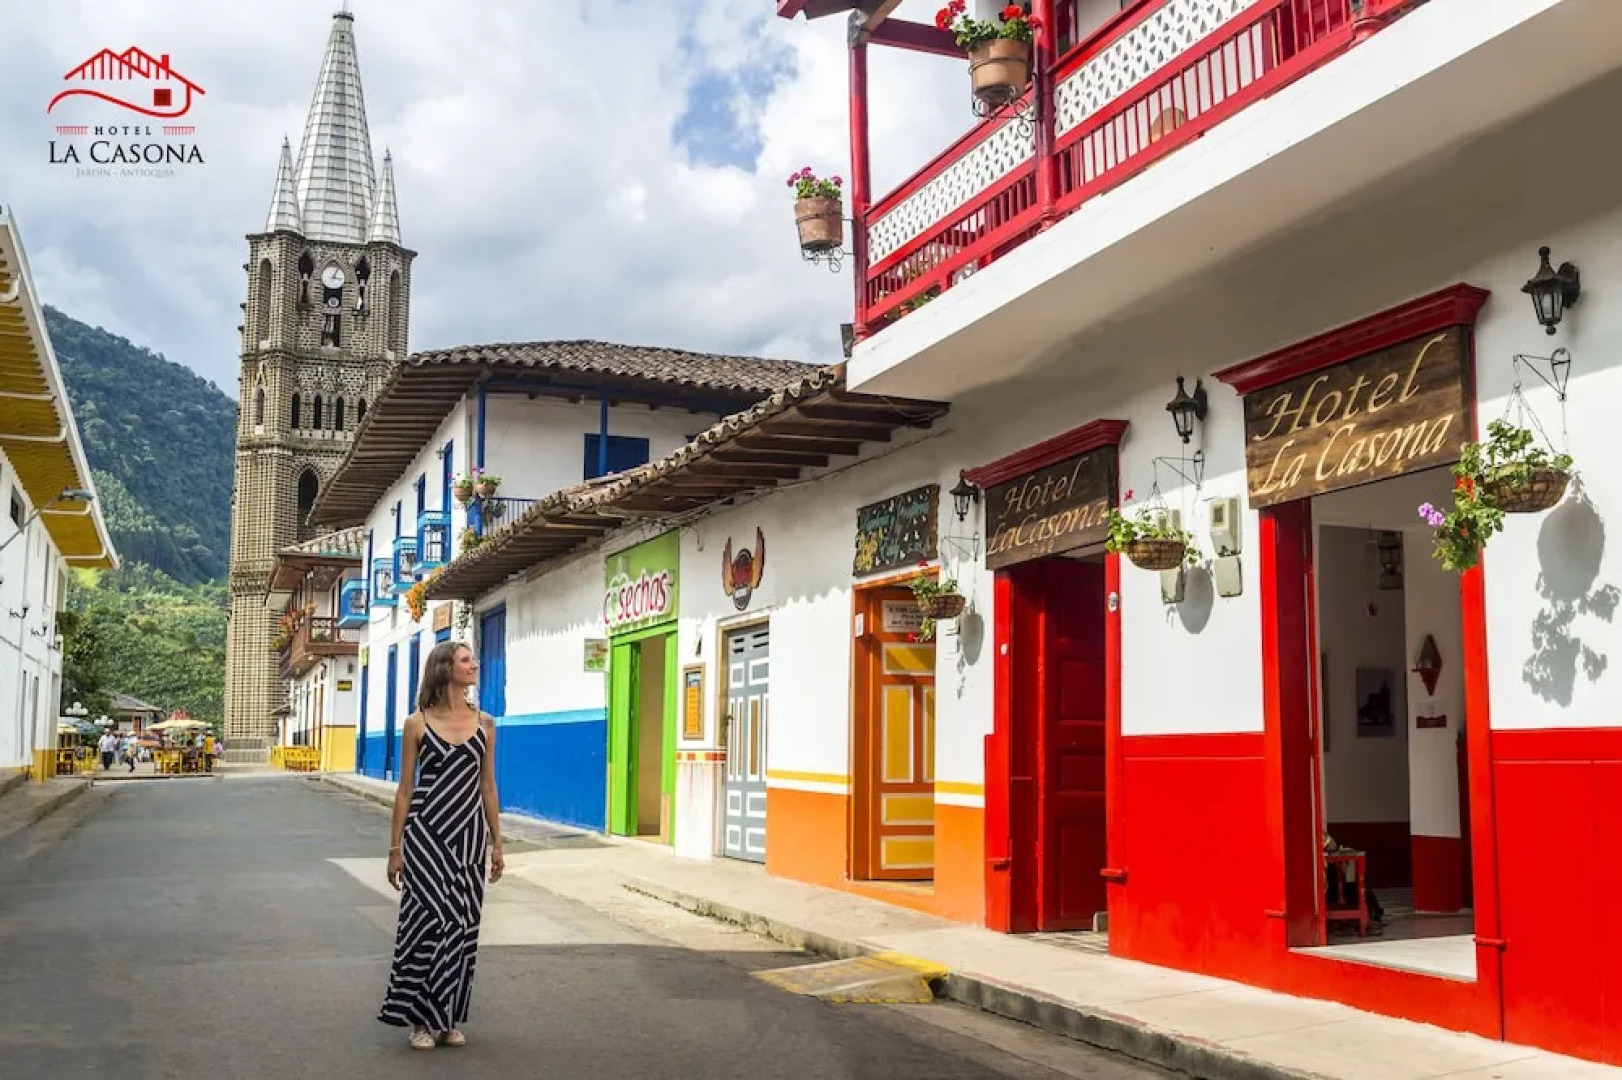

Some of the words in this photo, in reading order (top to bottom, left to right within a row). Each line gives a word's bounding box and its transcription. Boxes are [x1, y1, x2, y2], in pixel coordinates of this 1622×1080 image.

[1253, 333, 1447, 442] Hotel
[998, 456, 1090, 520] Hotel
[1249, 439, 1307, 497] La
[1315, 413, 1455, 482] Casona
